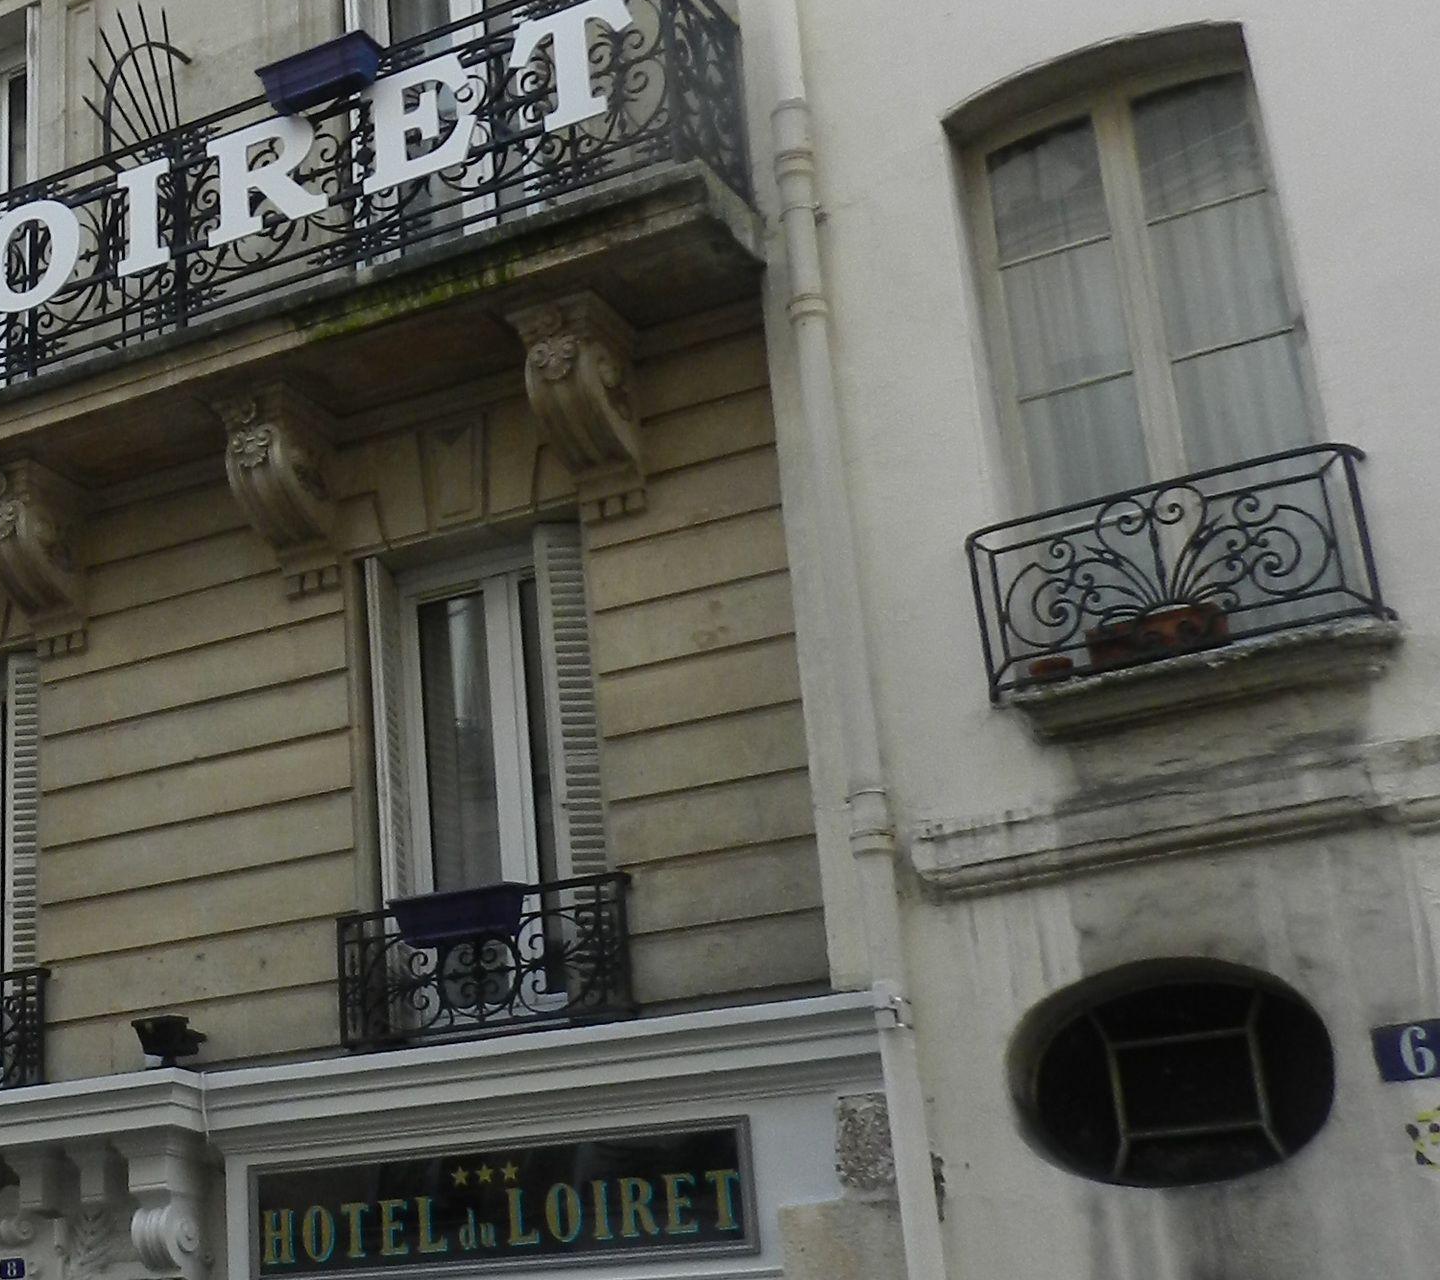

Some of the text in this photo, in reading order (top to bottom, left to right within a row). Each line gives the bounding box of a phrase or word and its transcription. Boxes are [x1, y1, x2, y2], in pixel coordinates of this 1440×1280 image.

[1400, 1025, 1436, 1076] 6
[263, 1168, 741, 1266] HOTEL du LOIRET
